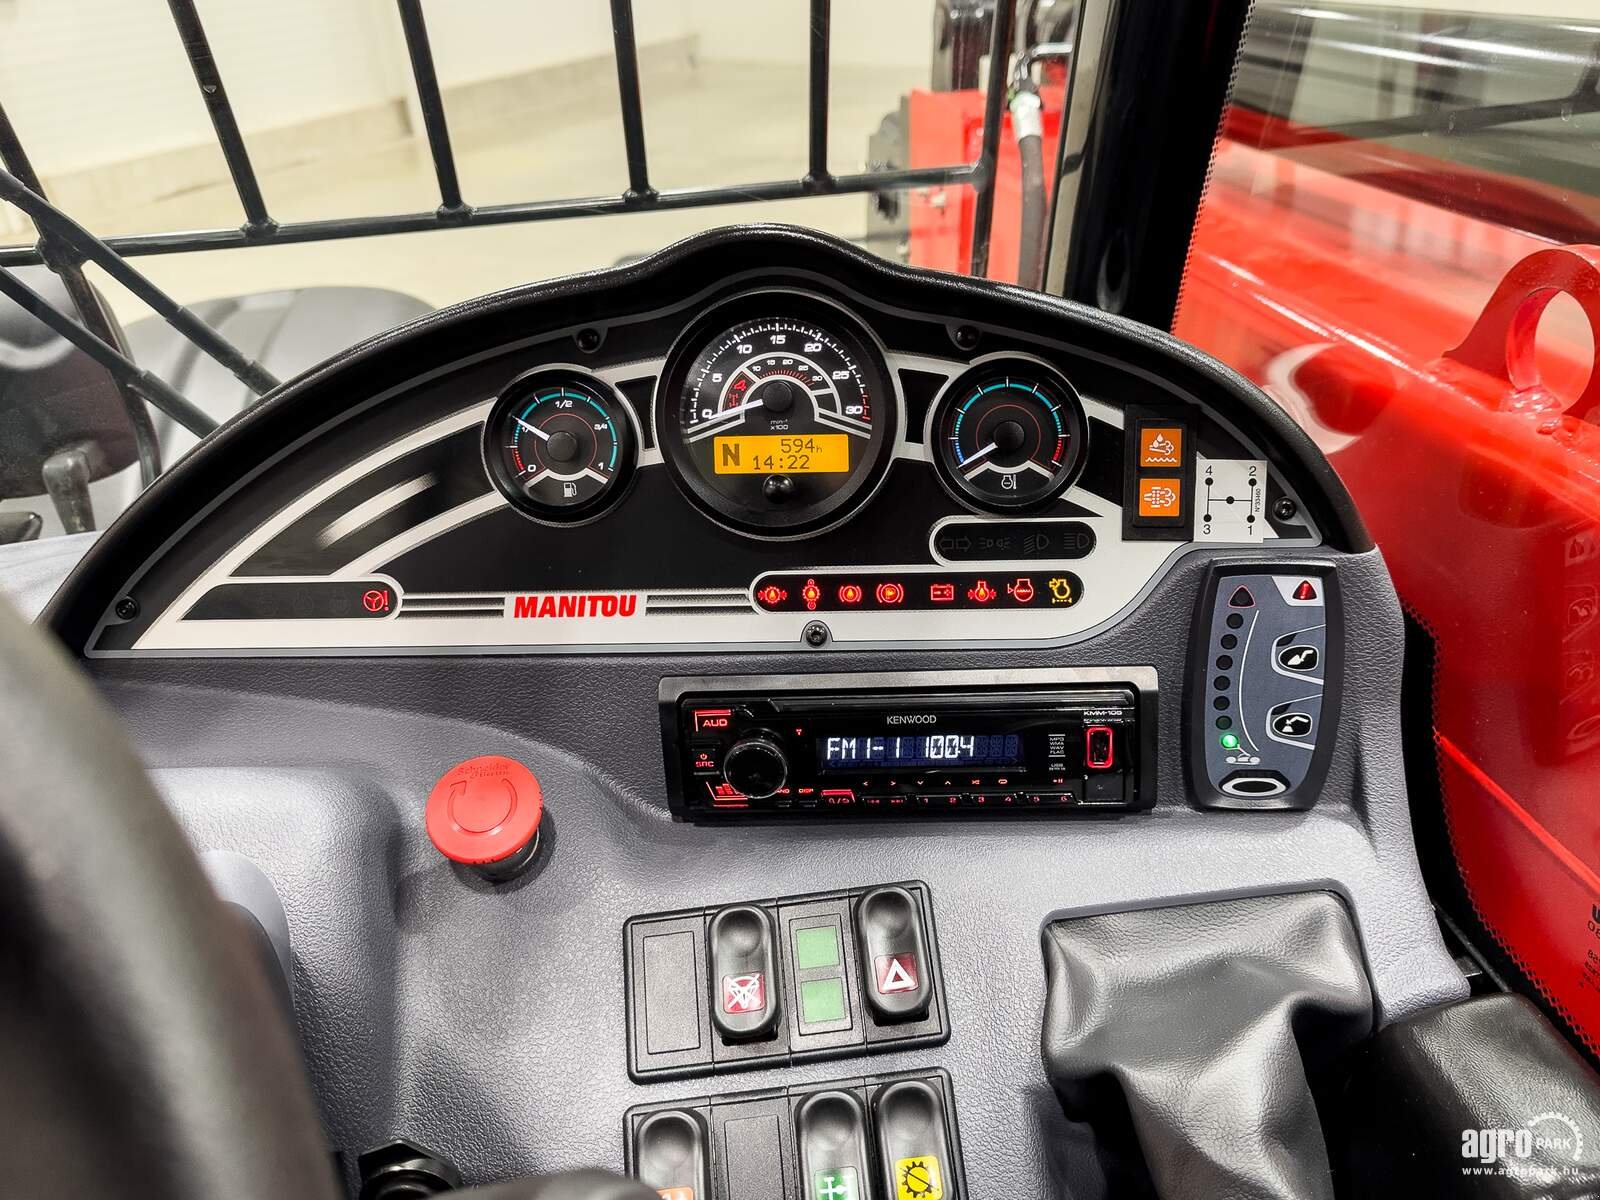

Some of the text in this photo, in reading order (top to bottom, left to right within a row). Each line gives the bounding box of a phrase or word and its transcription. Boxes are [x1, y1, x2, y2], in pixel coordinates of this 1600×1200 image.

[770, 335, 786, 345] 15
[736, 344, 752, 354] 10
[804, 343, 822, 352] 20
[712, 373, 723, 382] 5
[832, 370, 850, 380] 25
[555, 401, 573, 409] 1/2
[702, 409, 712, 419] 0
[846, 406, 863, 415] 30
[722, 443, 740, 467] N
[598, 462, 604, 470] 1
[752, 455, 810, 470] 14:22
[527, 464, 536, 472] 0
[1205, 465, 1213, 476] 4
[1249, 466, 1257, 477] 2
[1203, 524, 1211, 535] 3
[1247, 525, 1252, 536] 1
[513, 594, 637, 619] MANITOU
[702, 718, 728, 727] AUD
[886, 715, 937, 725] KENWOOD
